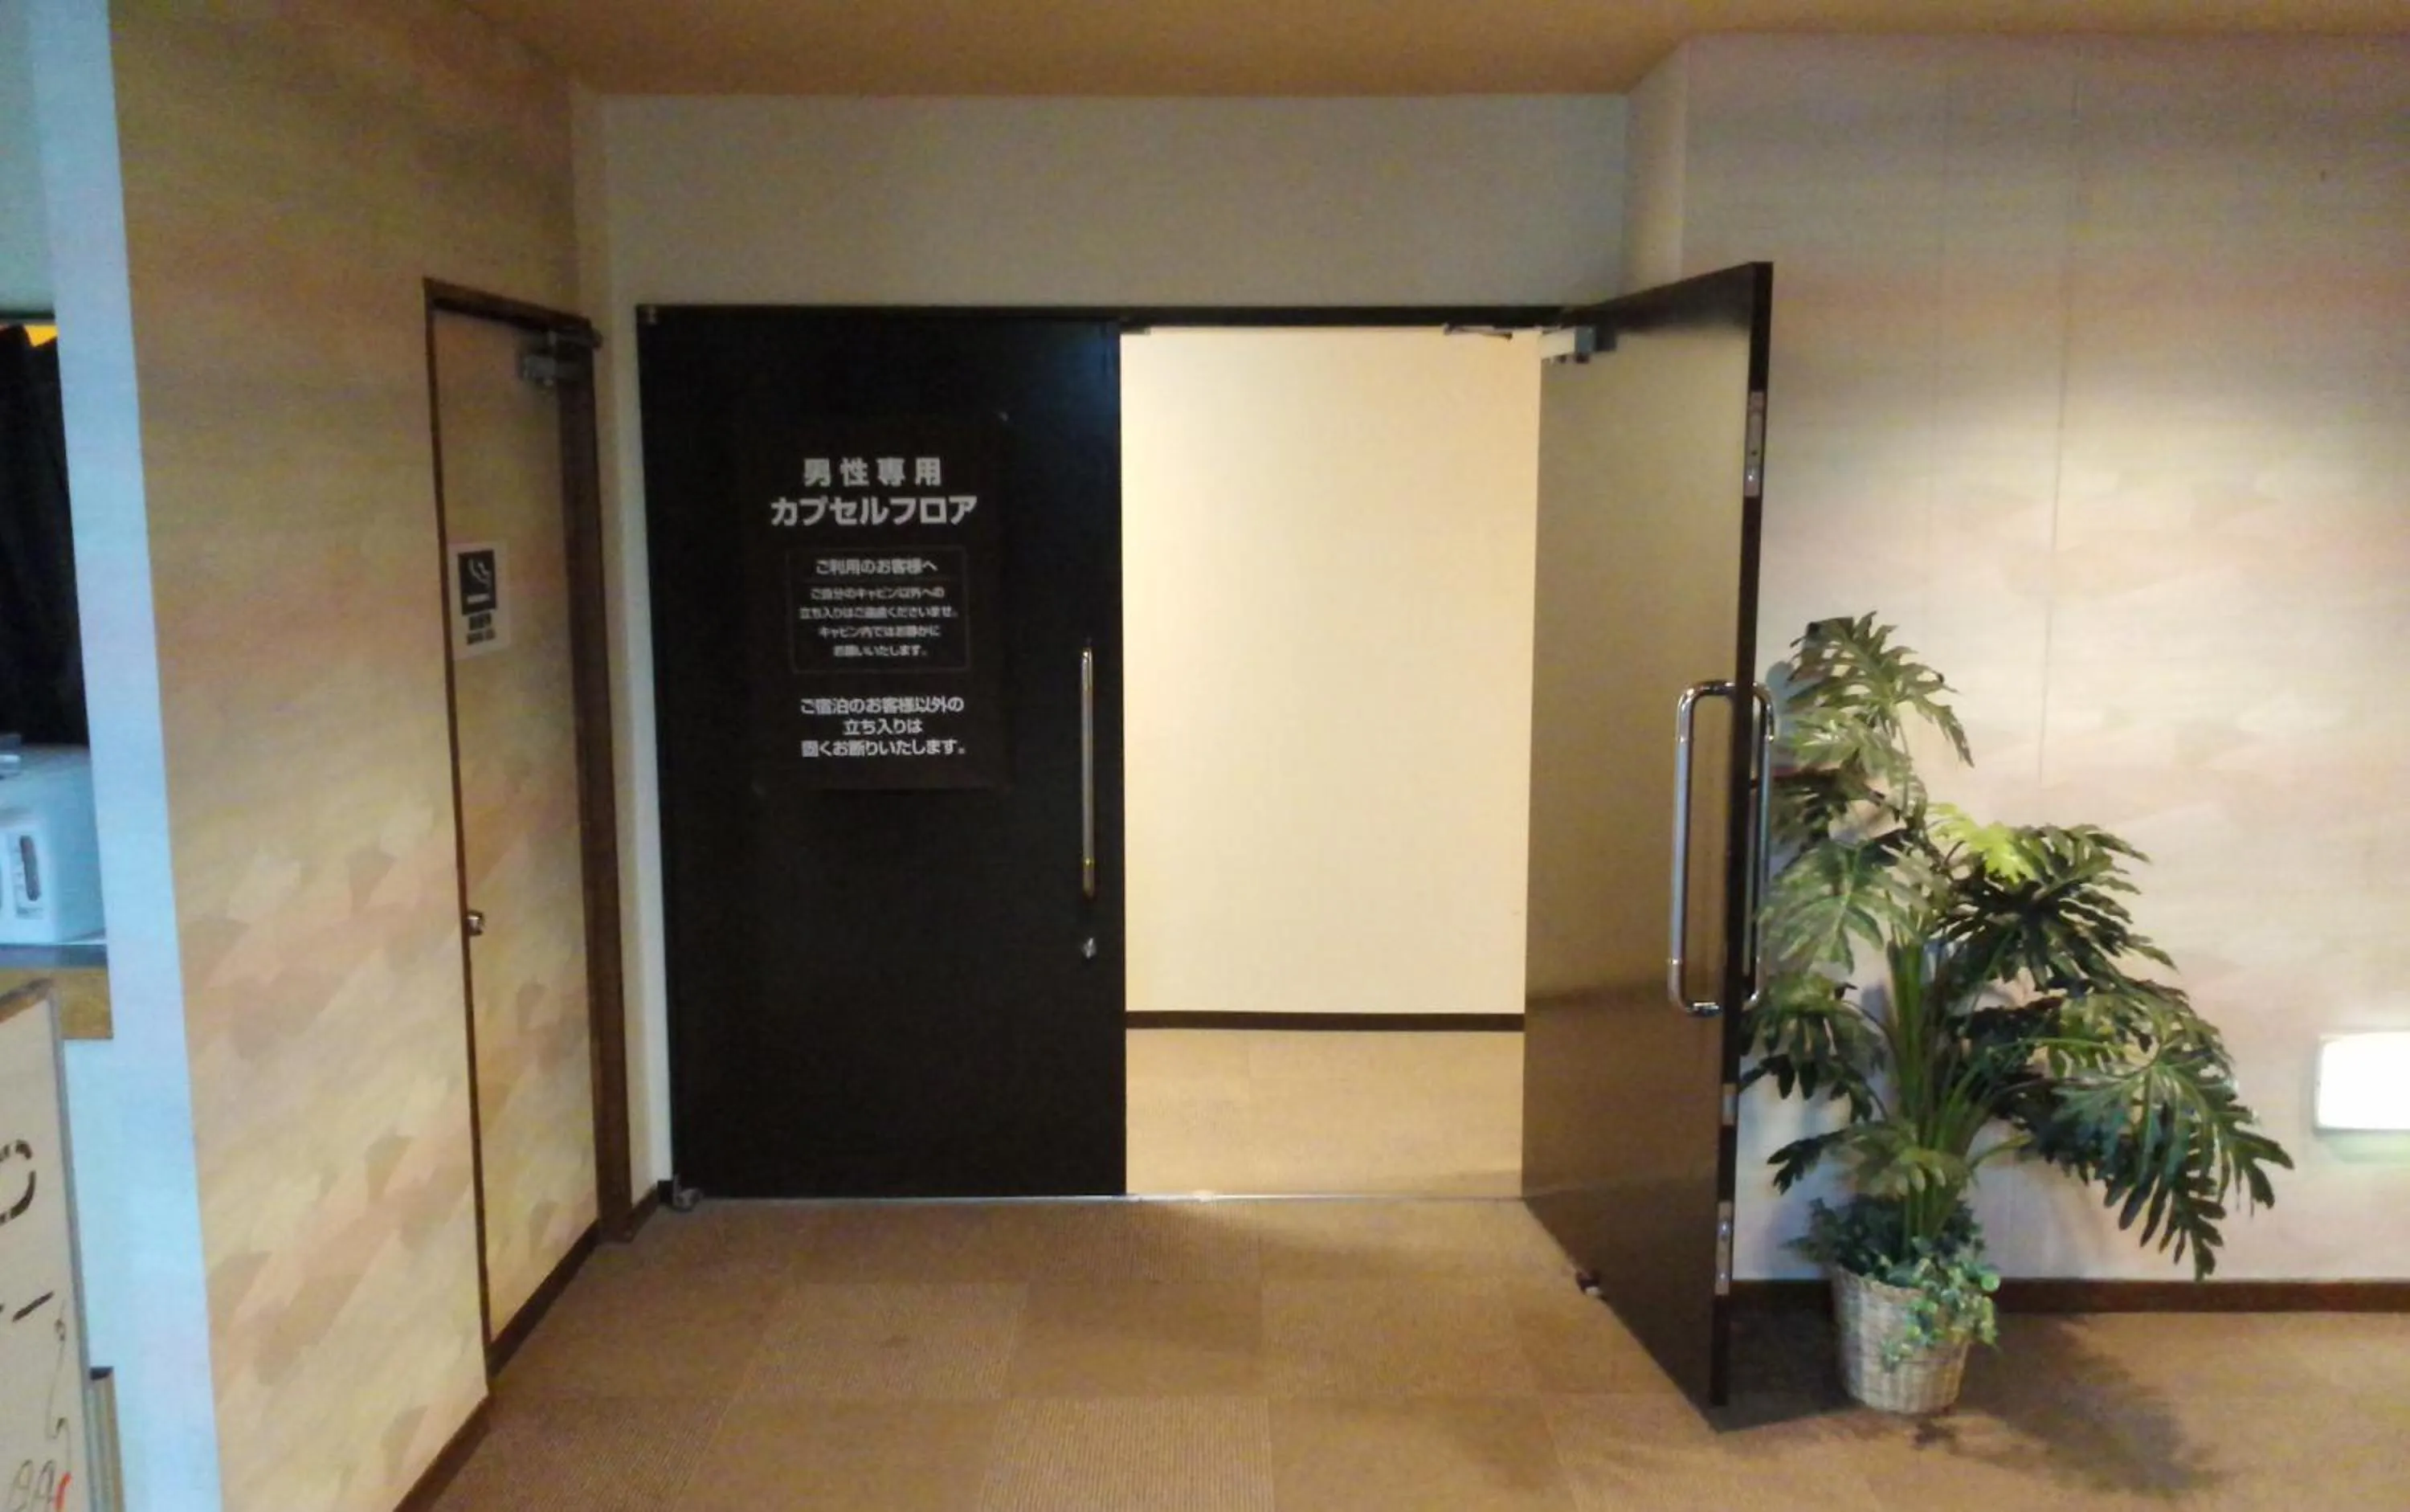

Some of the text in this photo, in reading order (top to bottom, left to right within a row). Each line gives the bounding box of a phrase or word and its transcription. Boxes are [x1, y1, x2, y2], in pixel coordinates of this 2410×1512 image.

[803, 456, 942, 486] 男性専用
[771, 495, 978, 525] カプセルフロア
[801, 697, 965, 714] ご宿泊のお客様以外の
[844, 718, 923, 736] 立ち入りは
